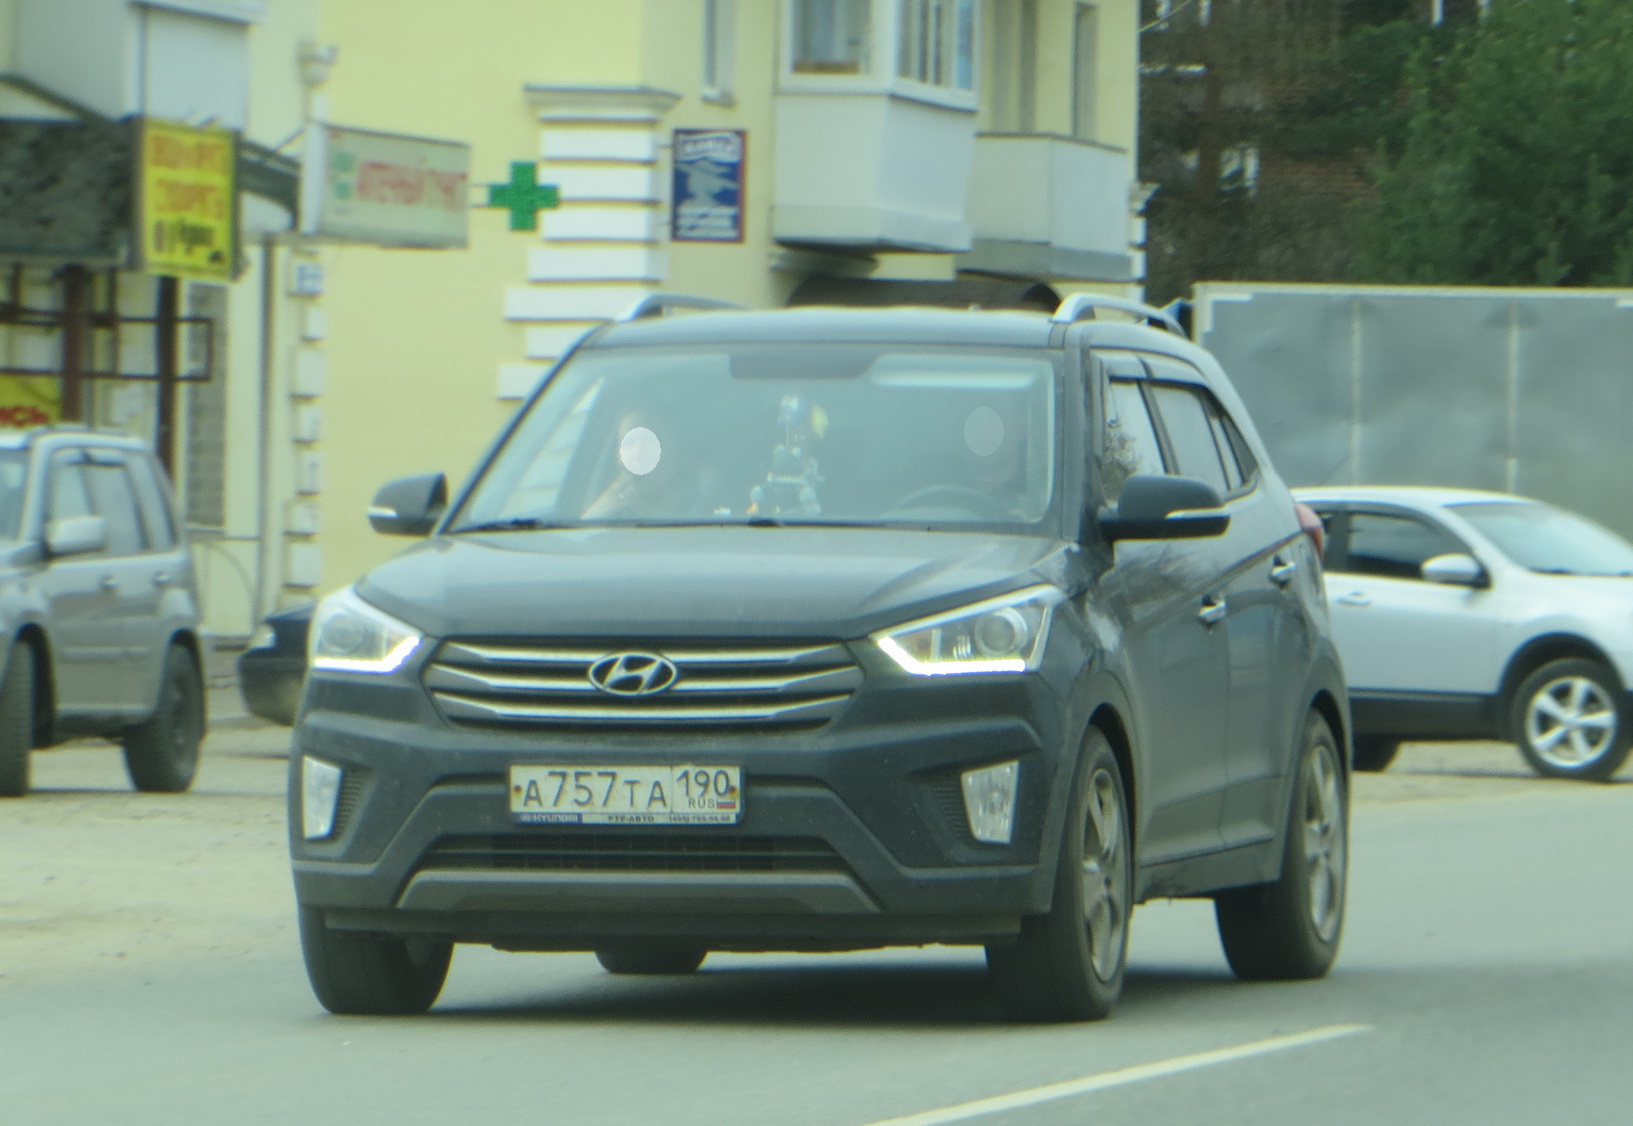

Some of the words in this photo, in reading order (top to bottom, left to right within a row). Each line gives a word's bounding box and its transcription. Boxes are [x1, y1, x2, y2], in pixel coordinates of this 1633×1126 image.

[677, 769, 732, 798] 190
[688, 798, 716, 809] RUS
[532, 812, 579, 823] HYUNDAI
